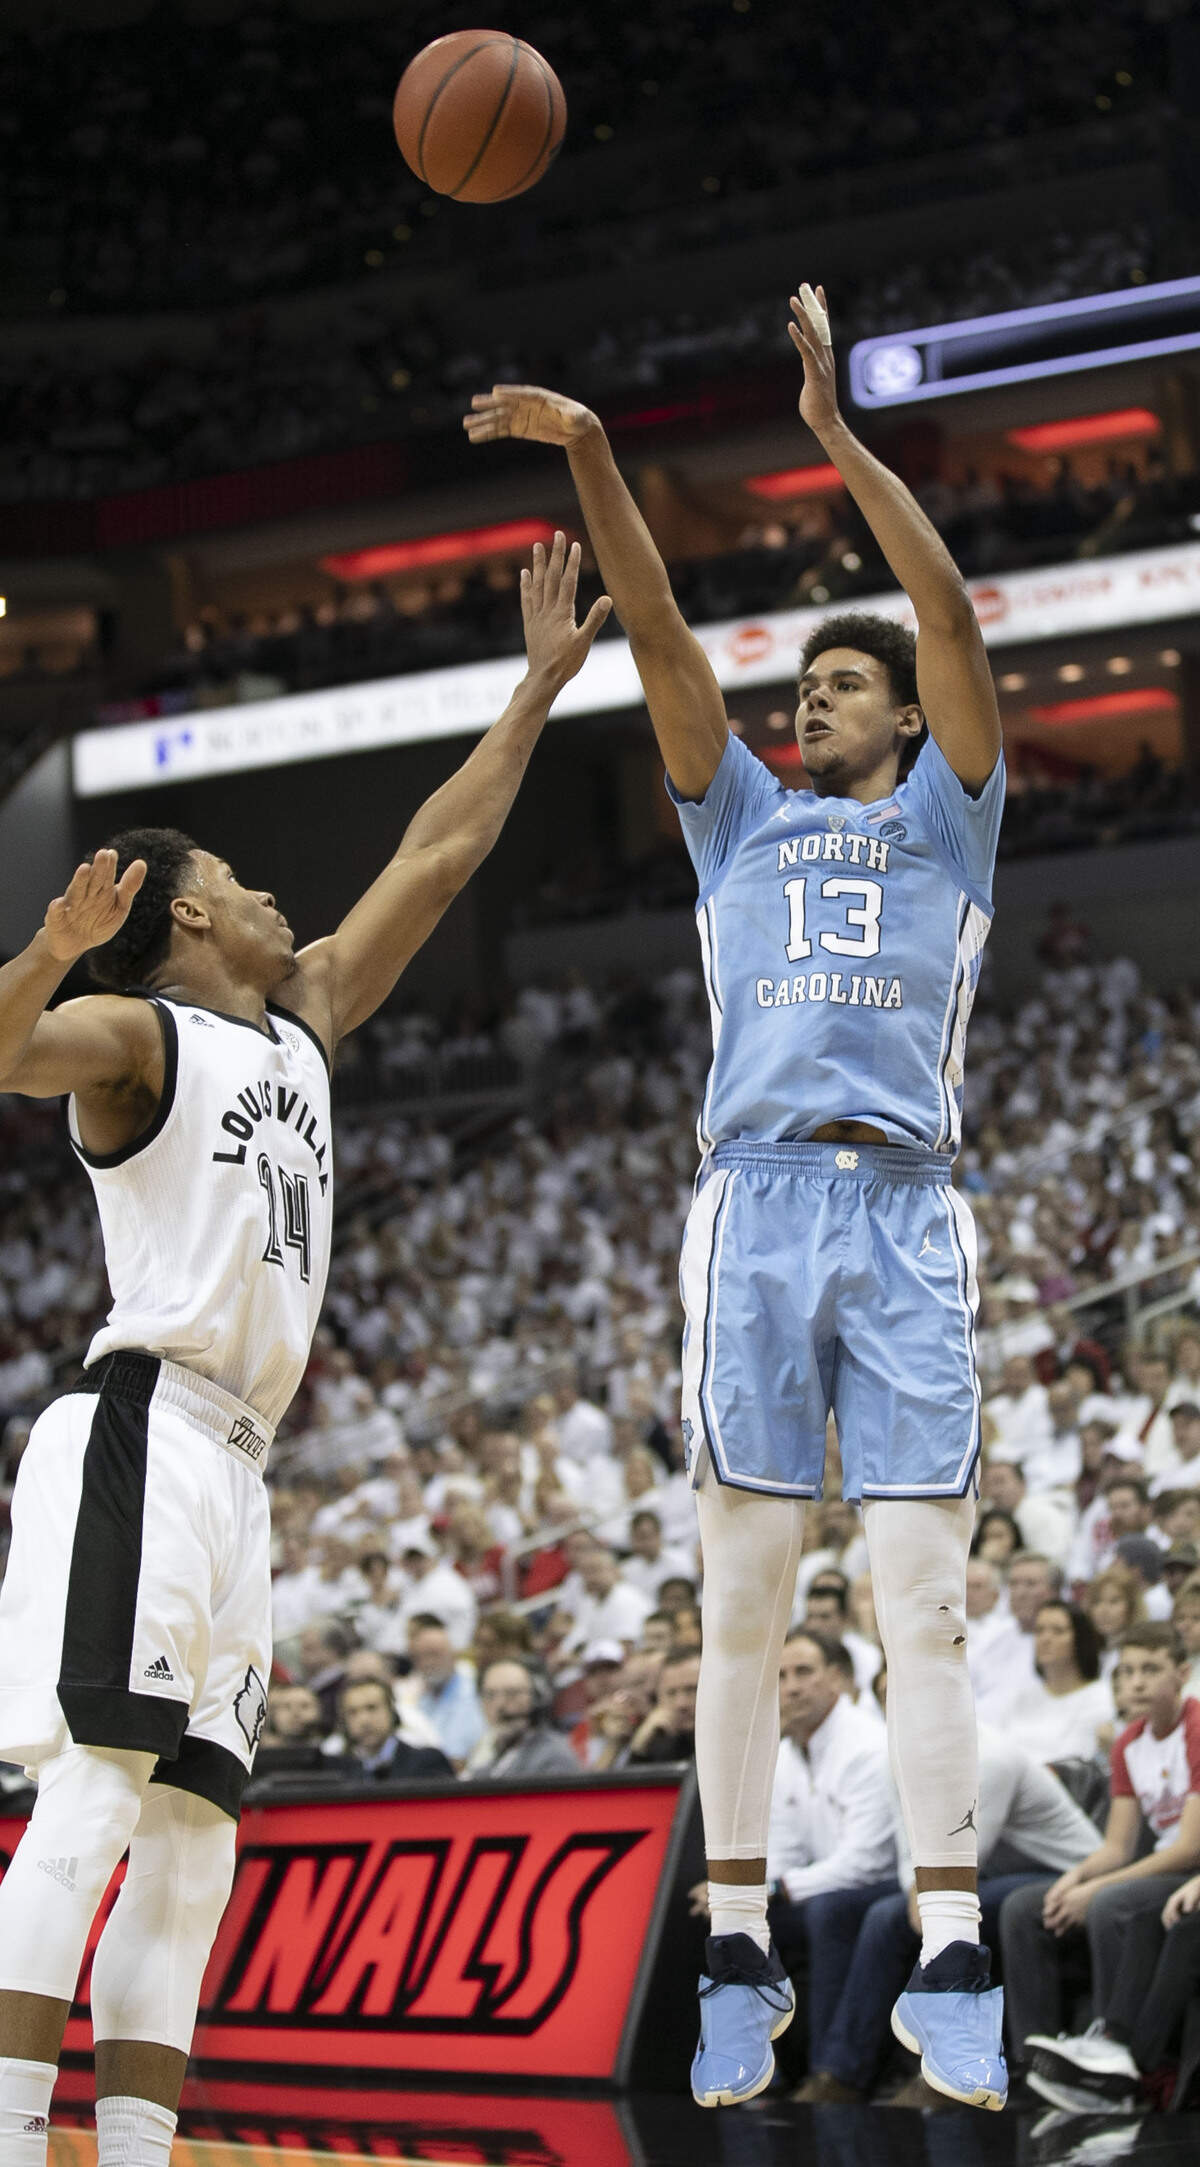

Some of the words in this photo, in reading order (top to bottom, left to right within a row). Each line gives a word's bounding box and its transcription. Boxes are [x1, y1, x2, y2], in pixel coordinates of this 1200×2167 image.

[777, 833, 890, 873] NORTH
[783, 877, 885, 963] 13
[756, 972, 905, 1009] CAROLINA
[257, 1152, 311, 1286] 14
[143, 1669, 174, 1682] adidas
[37, 1860, 77, 1892] adidas
[72, 1828, 655, 2036] INALS
